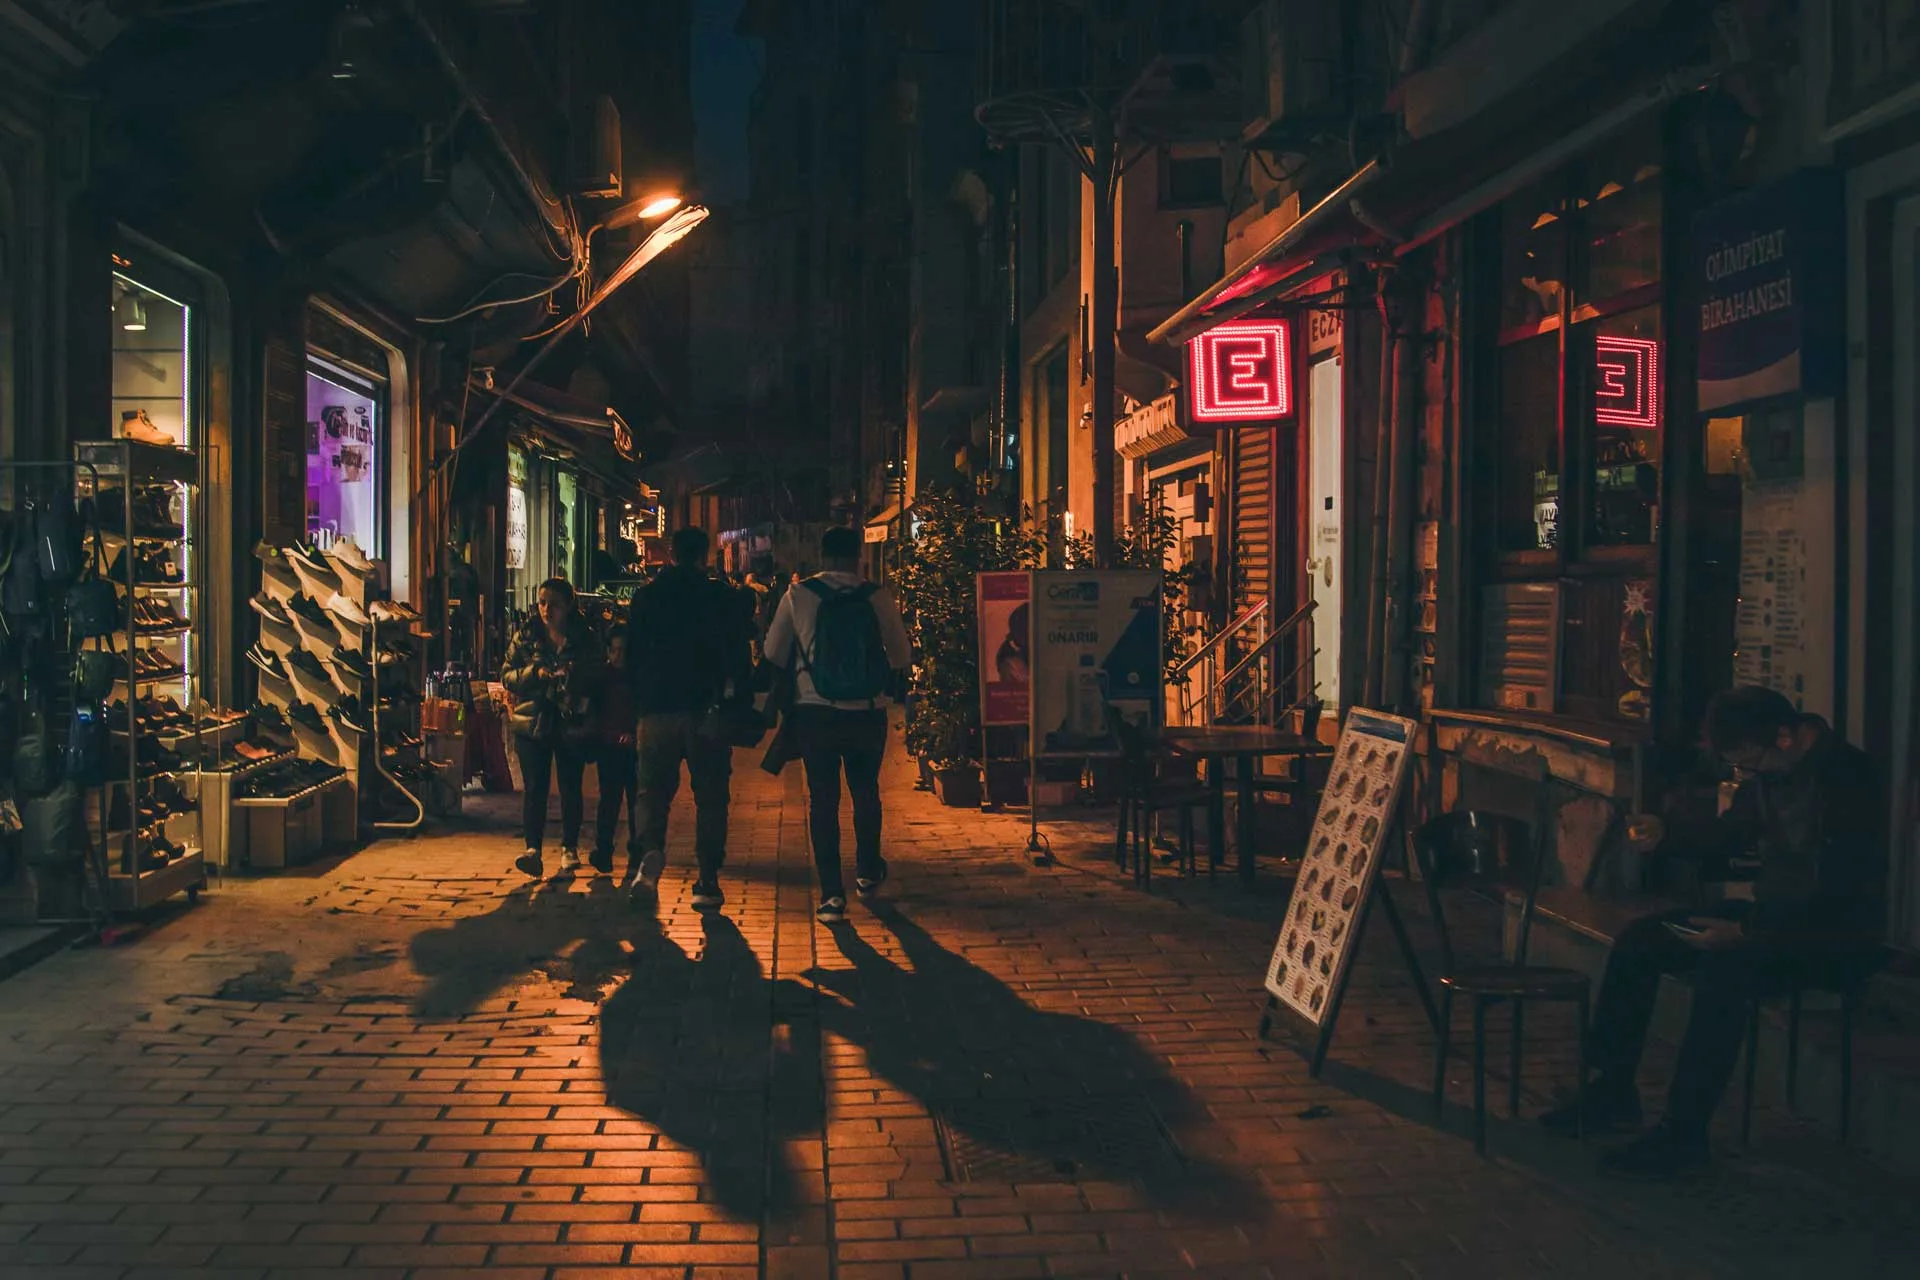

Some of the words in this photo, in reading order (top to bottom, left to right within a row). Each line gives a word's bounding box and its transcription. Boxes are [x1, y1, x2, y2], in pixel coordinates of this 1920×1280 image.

[1705, 229, 1785, 281] OLİMPİYAT
[1701, 269, 1792, 331] BİRAHANESİ
[1211, 336, 1270, 406] E
[1049, 631, 1099, 644] ONARIR
